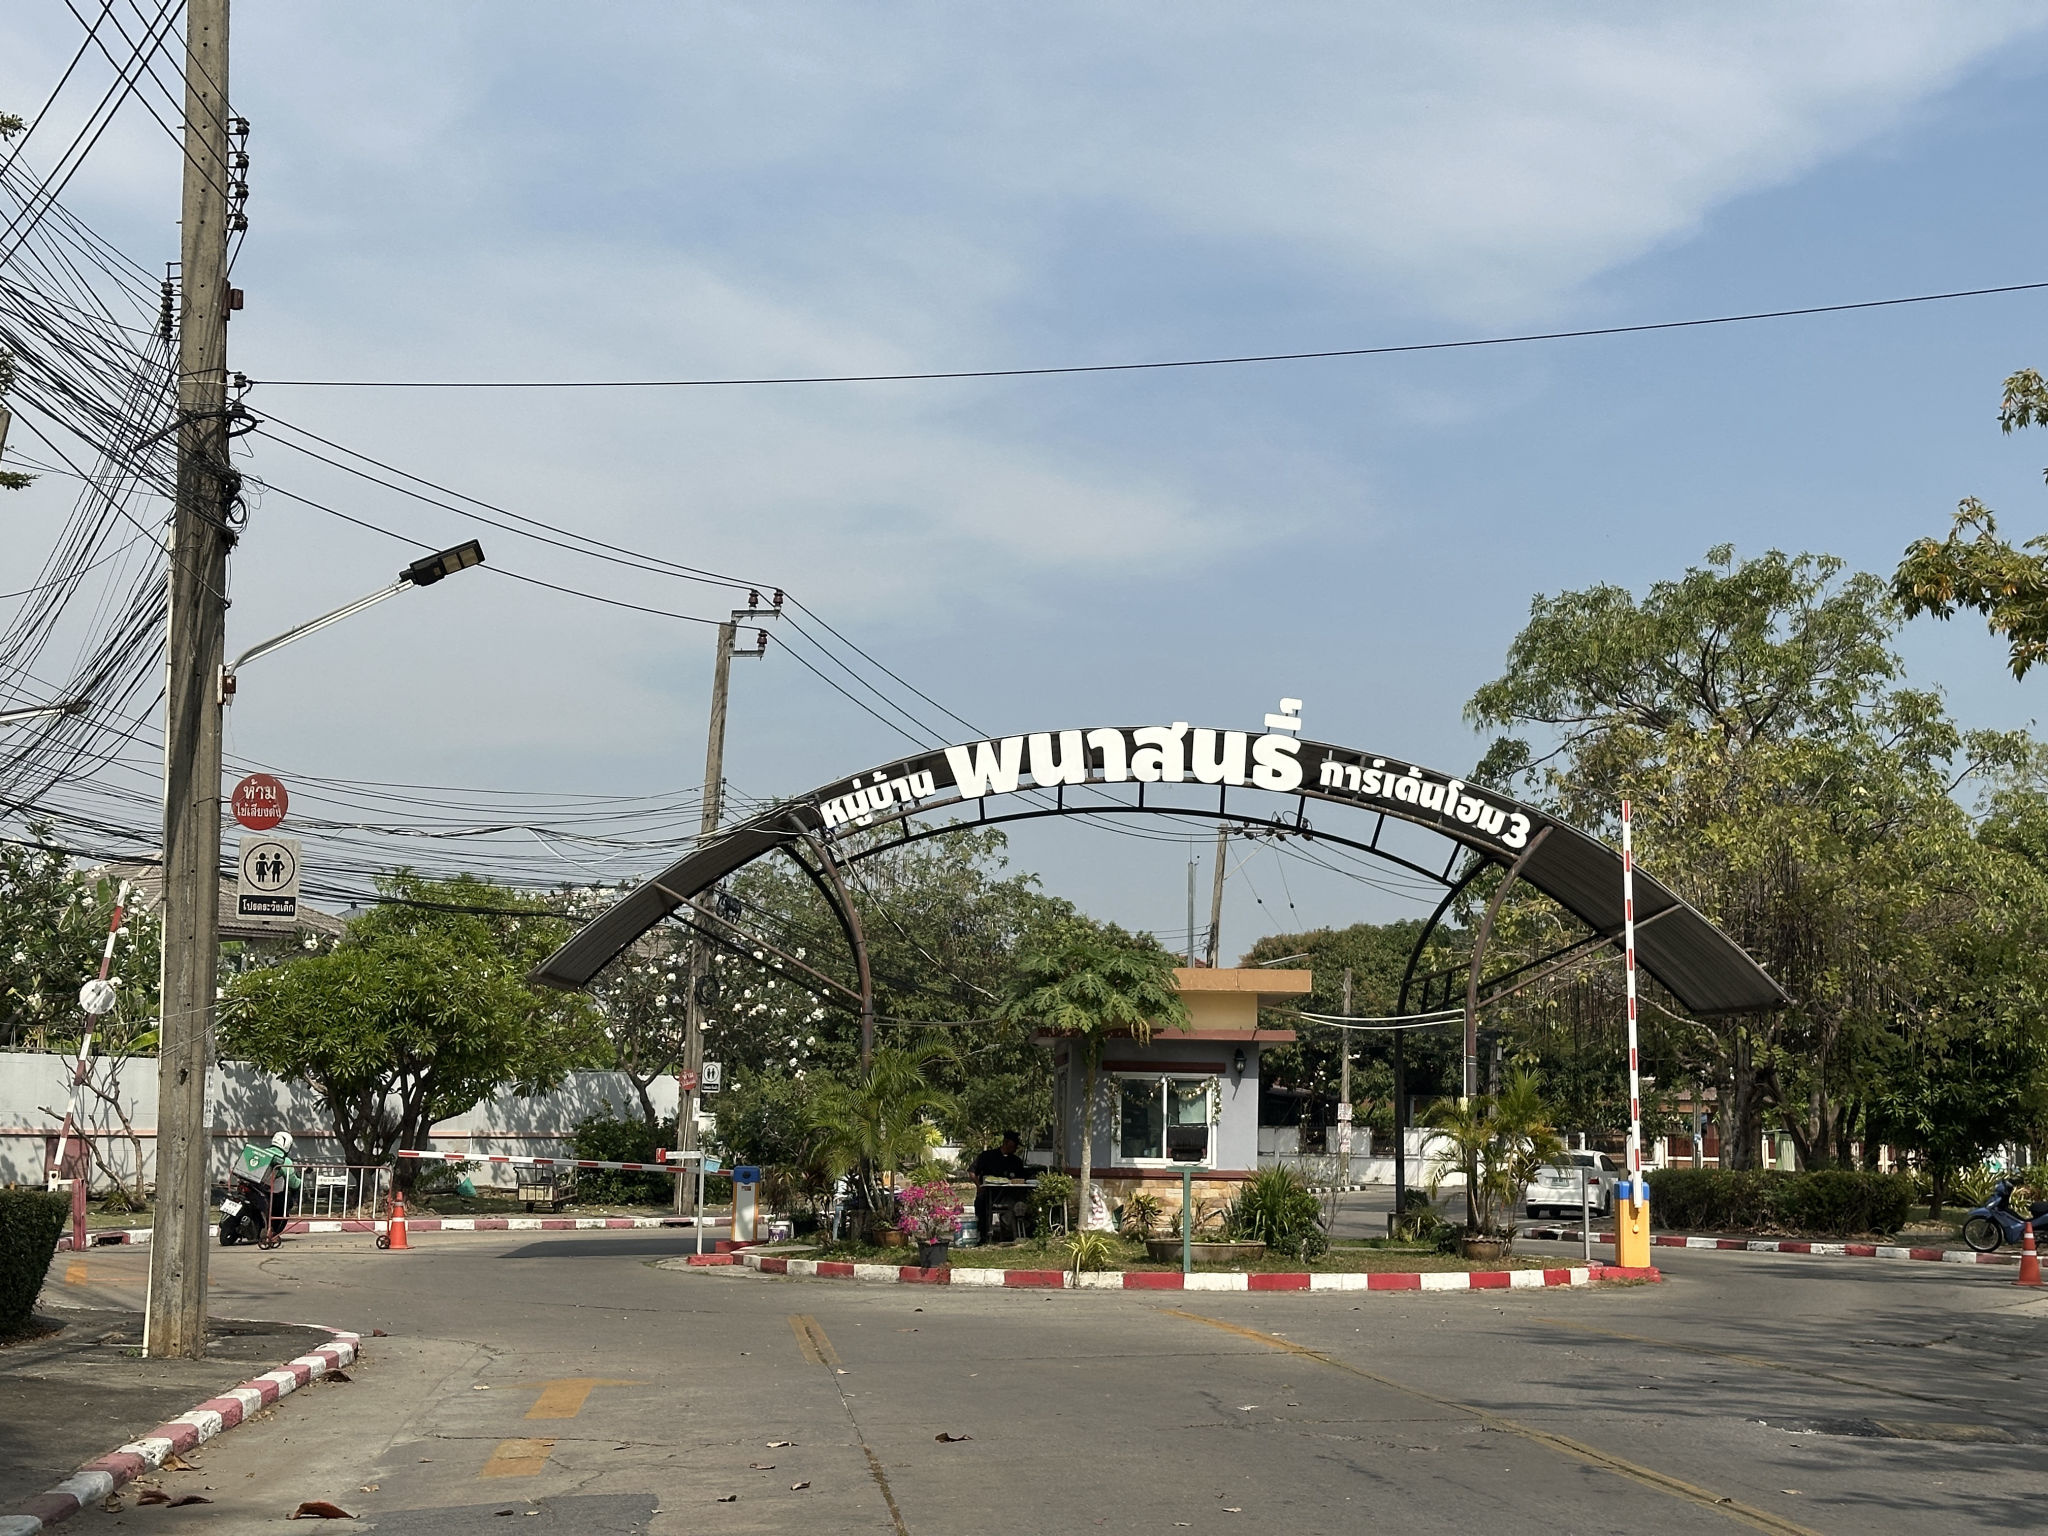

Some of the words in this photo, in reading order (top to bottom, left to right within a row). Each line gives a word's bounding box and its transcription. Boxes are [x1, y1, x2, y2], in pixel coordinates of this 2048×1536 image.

[820, 771, 936, 829] หมู่บ้าน
[945, 697, 1303, 799] พนาสนธิ์
[243, 778, 276, 800] ห้าม
[242, 899, 294, 912] โปรดระวังเด็ก
